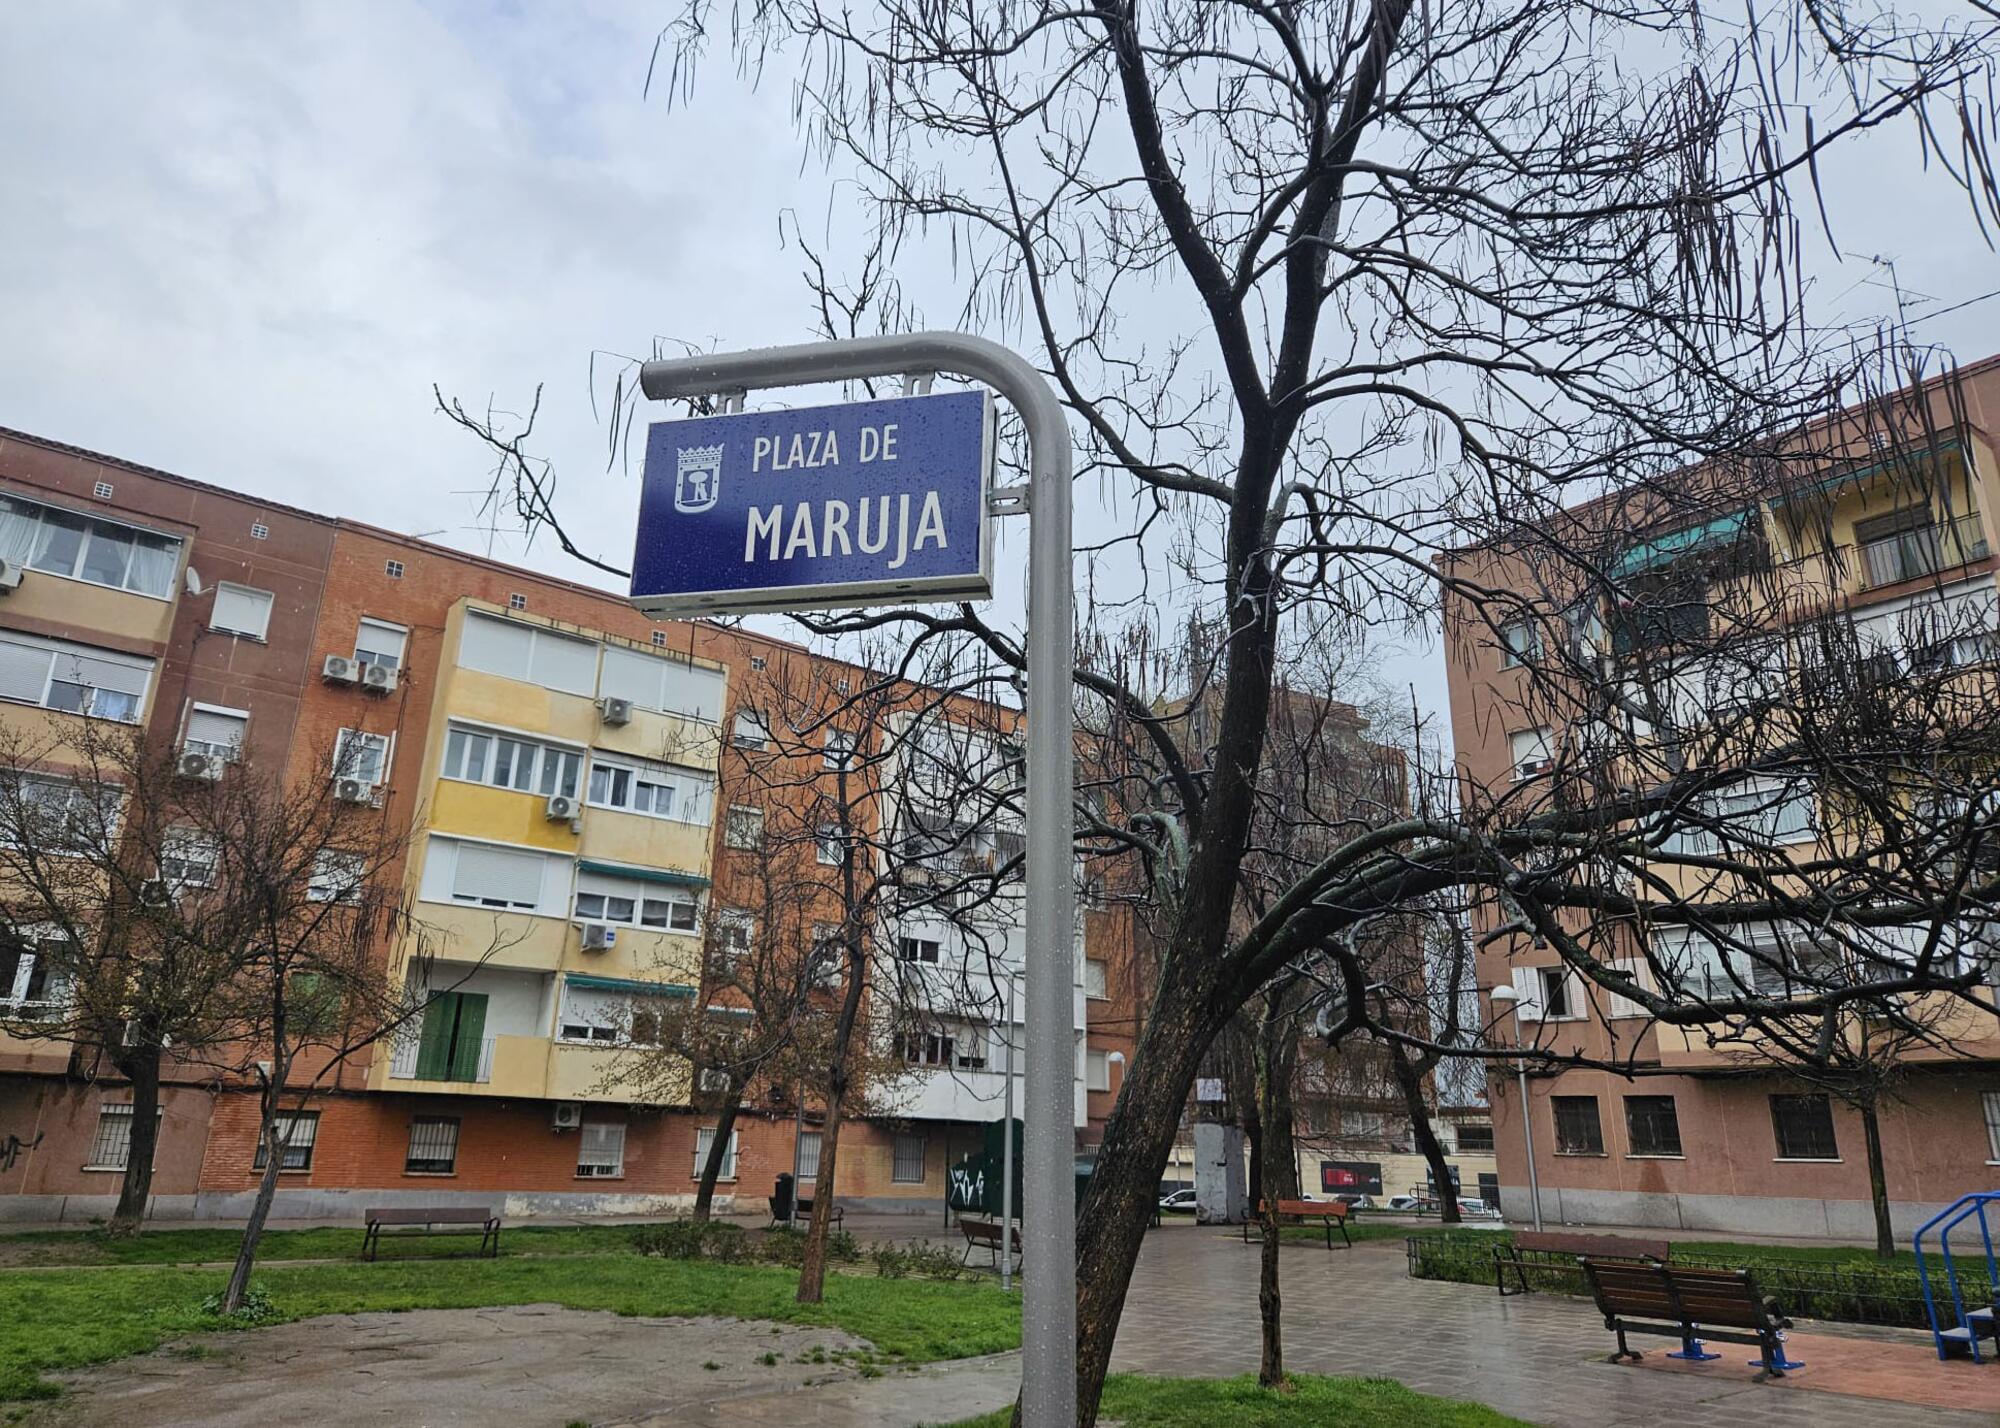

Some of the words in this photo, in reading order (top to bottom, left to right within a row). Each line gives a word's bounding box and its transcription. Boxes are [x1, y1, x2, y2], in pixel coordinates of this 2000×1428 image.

[753, 430, 840, 472] PLAZA
[860, 424, 898, 463] DE
[744, 491, 948, 569] MARUJA
